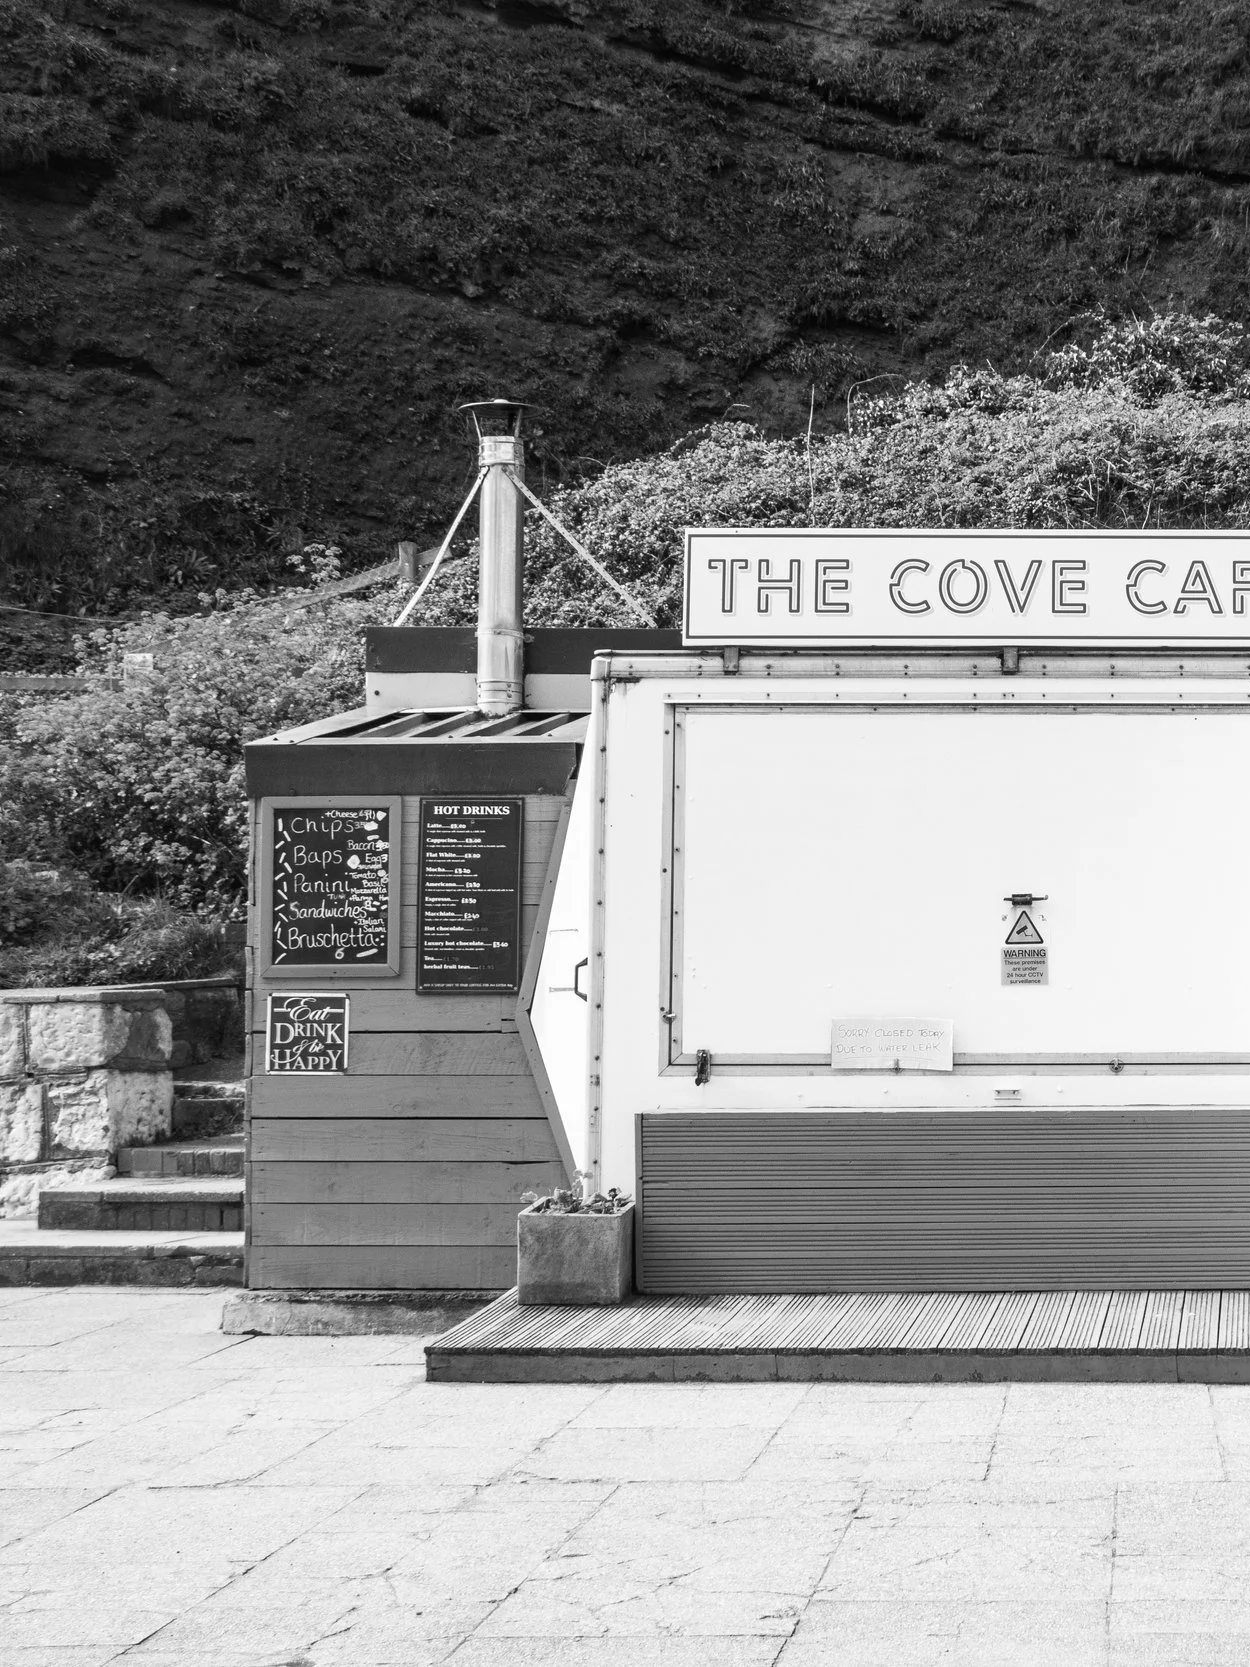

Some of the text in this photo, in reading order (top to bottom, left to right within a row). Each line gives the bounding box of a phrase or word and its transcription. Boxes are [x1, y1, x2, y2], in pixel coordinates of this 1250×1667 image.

[708, 558, 851, 615] THE
[888, 557, 1088, 616] COVE
[434, 806, 510, 815] HOT DRINKS
[291, 816, 354, 840] Chips
[346, 840, 374, 850] Bacon
[294, 845, 343, 870] Baps
[365, 853, 382, 866] Egg
[294, 873, 350, 892] Panini
[289, 900, 367, 920] Sandwiches
[288, 924, 378, 949] Bruschetta
[335, 947, 345, 960] 6
[1003, 949, 1046, 957] WARNING
[284, 998, 330, 1020] Eat
[273, 1022, 344, 1044] DRINK
[838, 1024, 870, 1038] SORRY
[874, 1028, 914, 1038] CLOSED
[836, 1044, 856, 1054] DUE
[879, 1044, 907, 1053] WATER
[912, 1043, 940, 1052] LEAK
[273, 1049, 343, 1070] HAPPY
